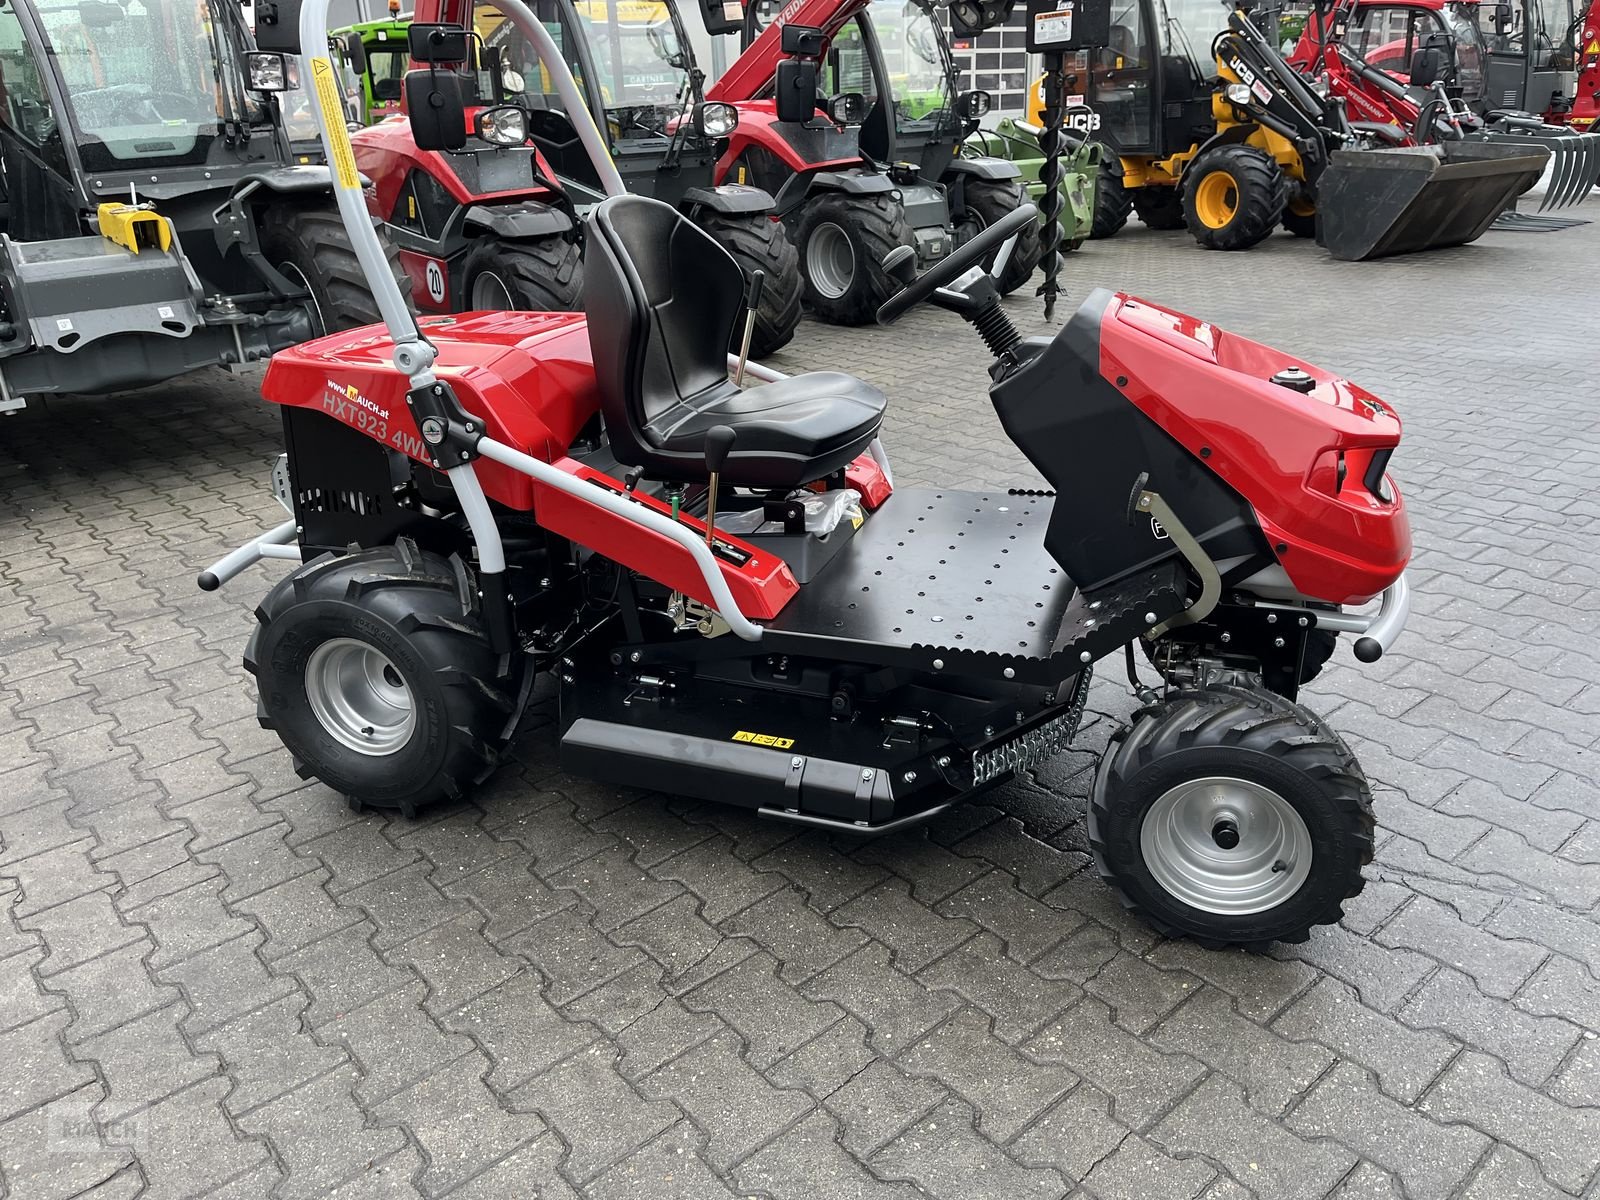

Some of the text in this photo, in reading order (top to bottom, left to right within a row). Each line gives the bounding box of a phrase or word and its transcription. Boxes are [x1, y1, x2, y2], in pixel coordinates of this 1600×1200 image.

[1229, 55, 1255, 86] JCB
[1347, 89, 1382, 118] WEIDEMANN
[1063, 113, 1101, 130] JCB
[429, 268, 442, 295] 20
[327, 379, 390, 420] www.MAUCH.at
[323, 391, 388, 440] HXT923
